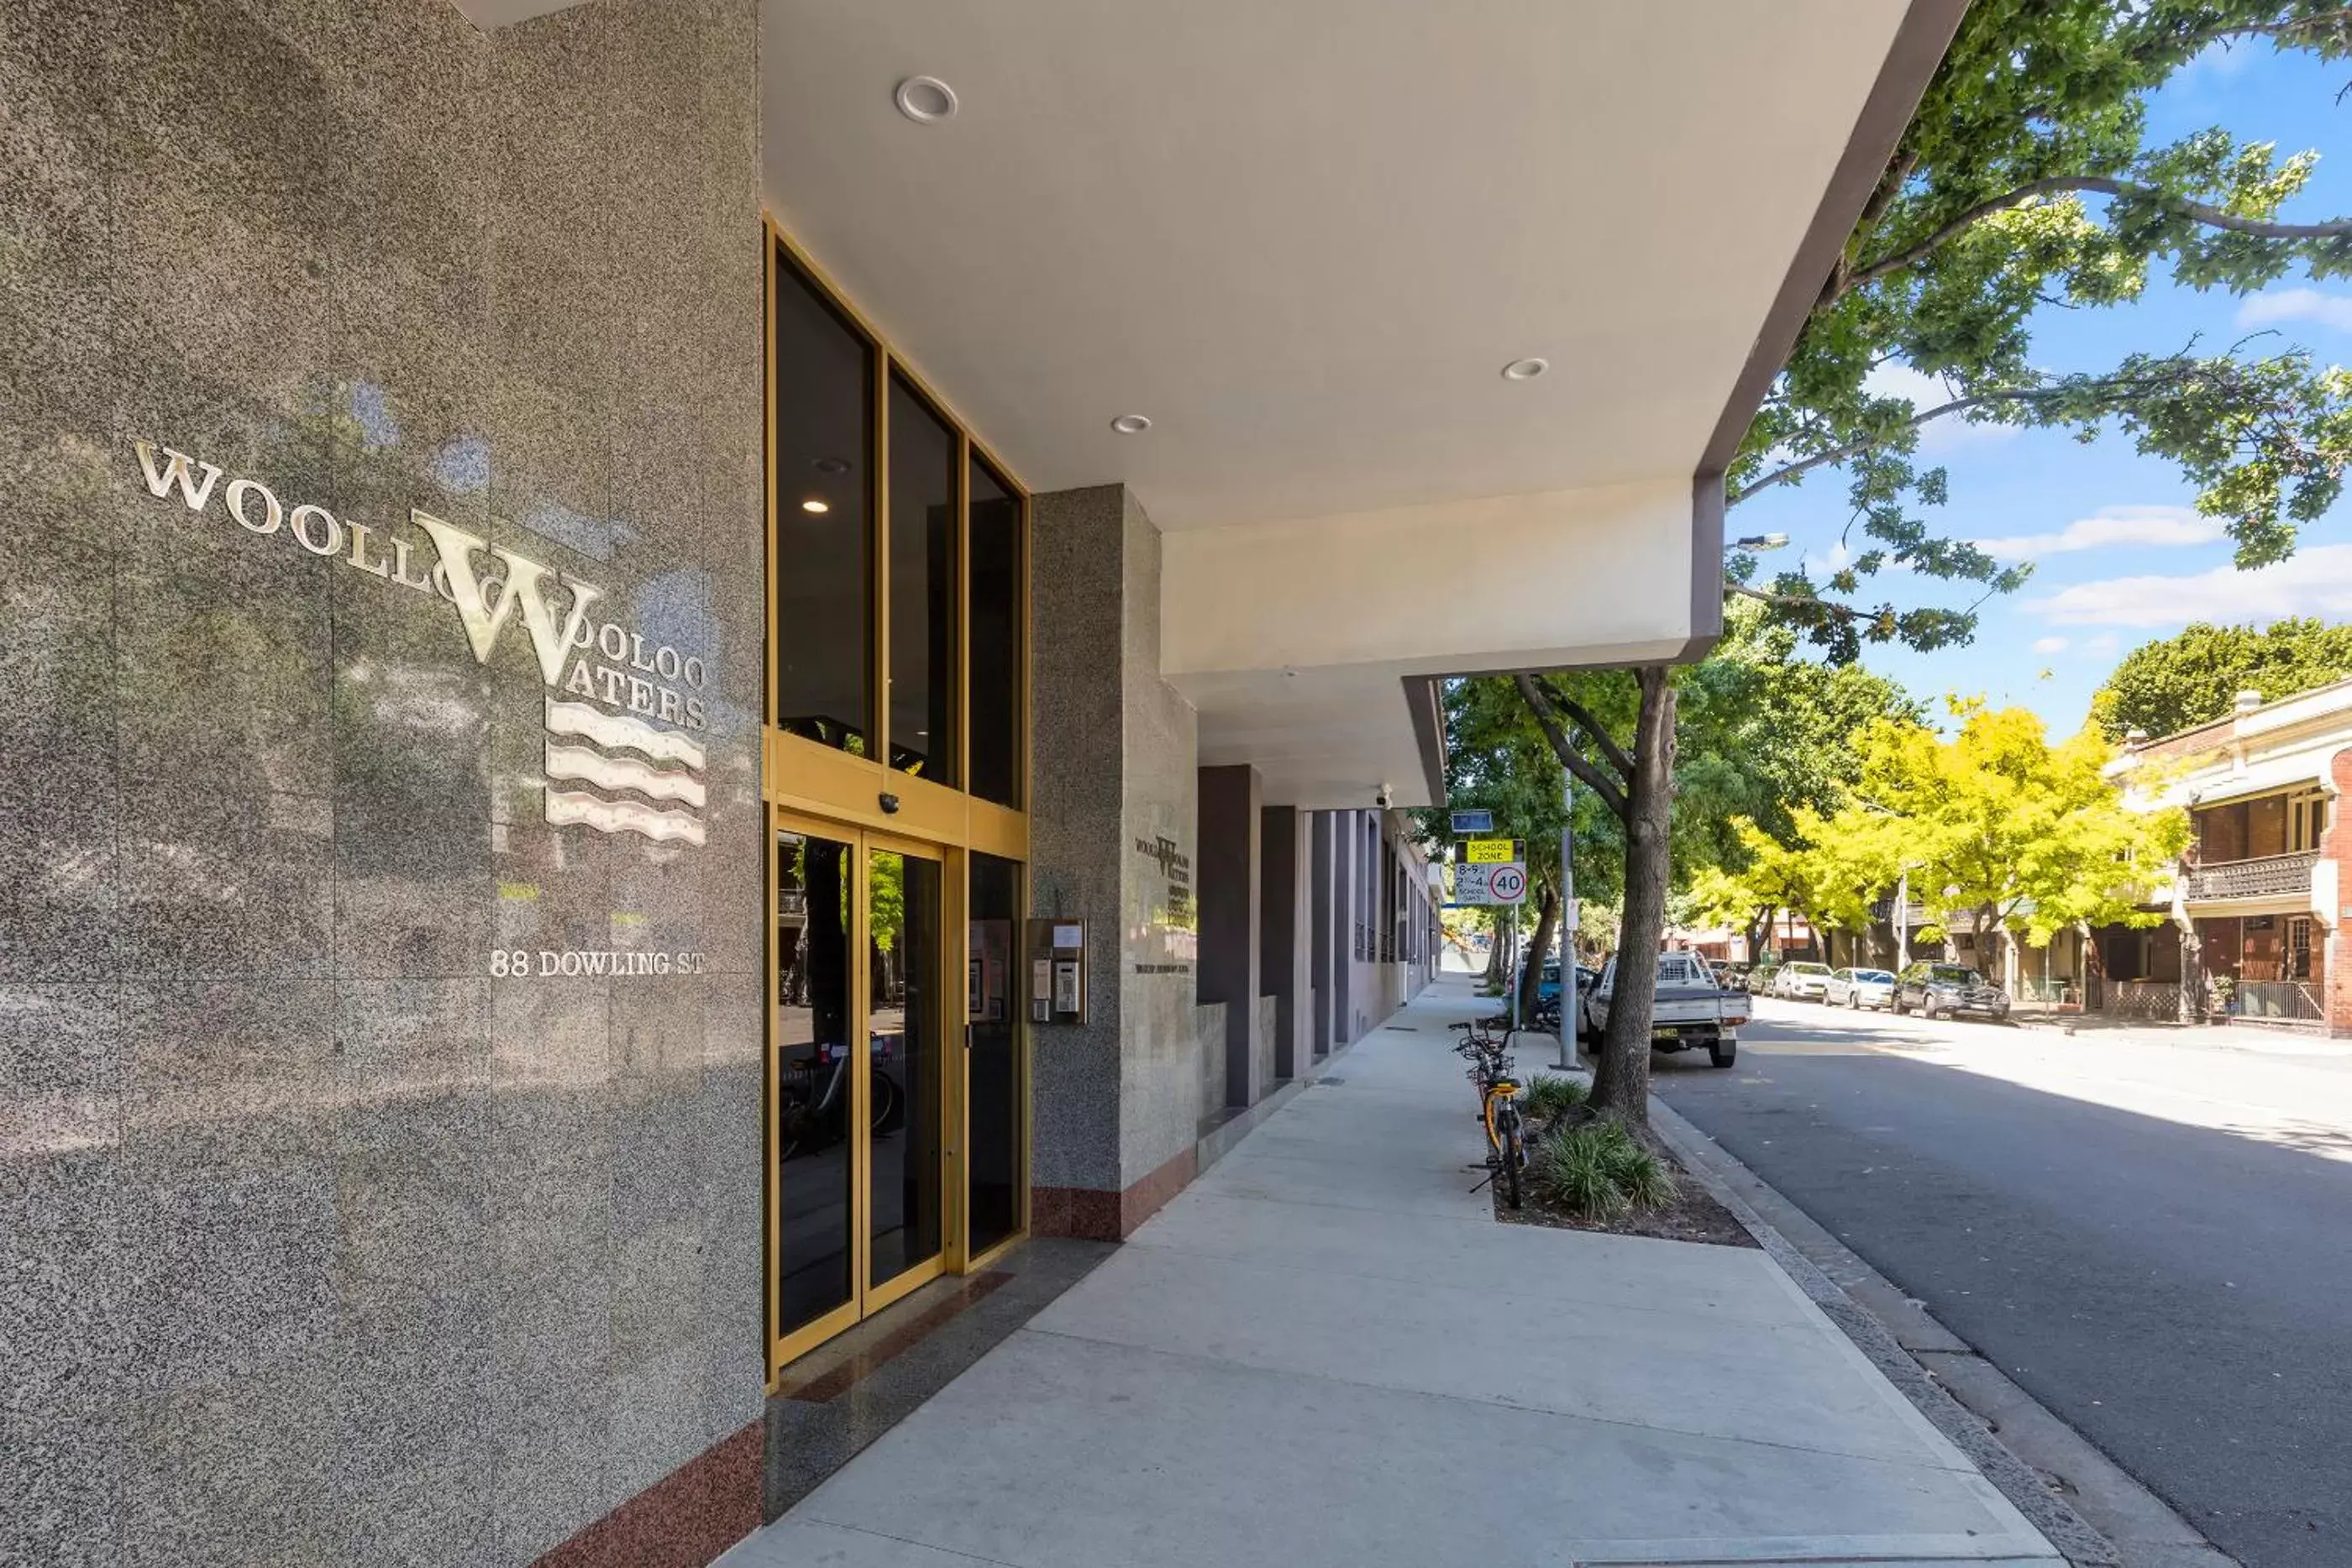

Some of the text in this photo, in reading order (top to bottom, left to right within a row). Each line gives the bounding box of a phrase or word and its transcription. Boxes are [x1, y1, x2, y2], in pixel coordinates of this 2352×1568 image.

[1471, 843, 1509, 852] SCHOOL
[1497, 876, 1520, 890] 40
[490, 949, 706, 978] 88 DOWLING ST
